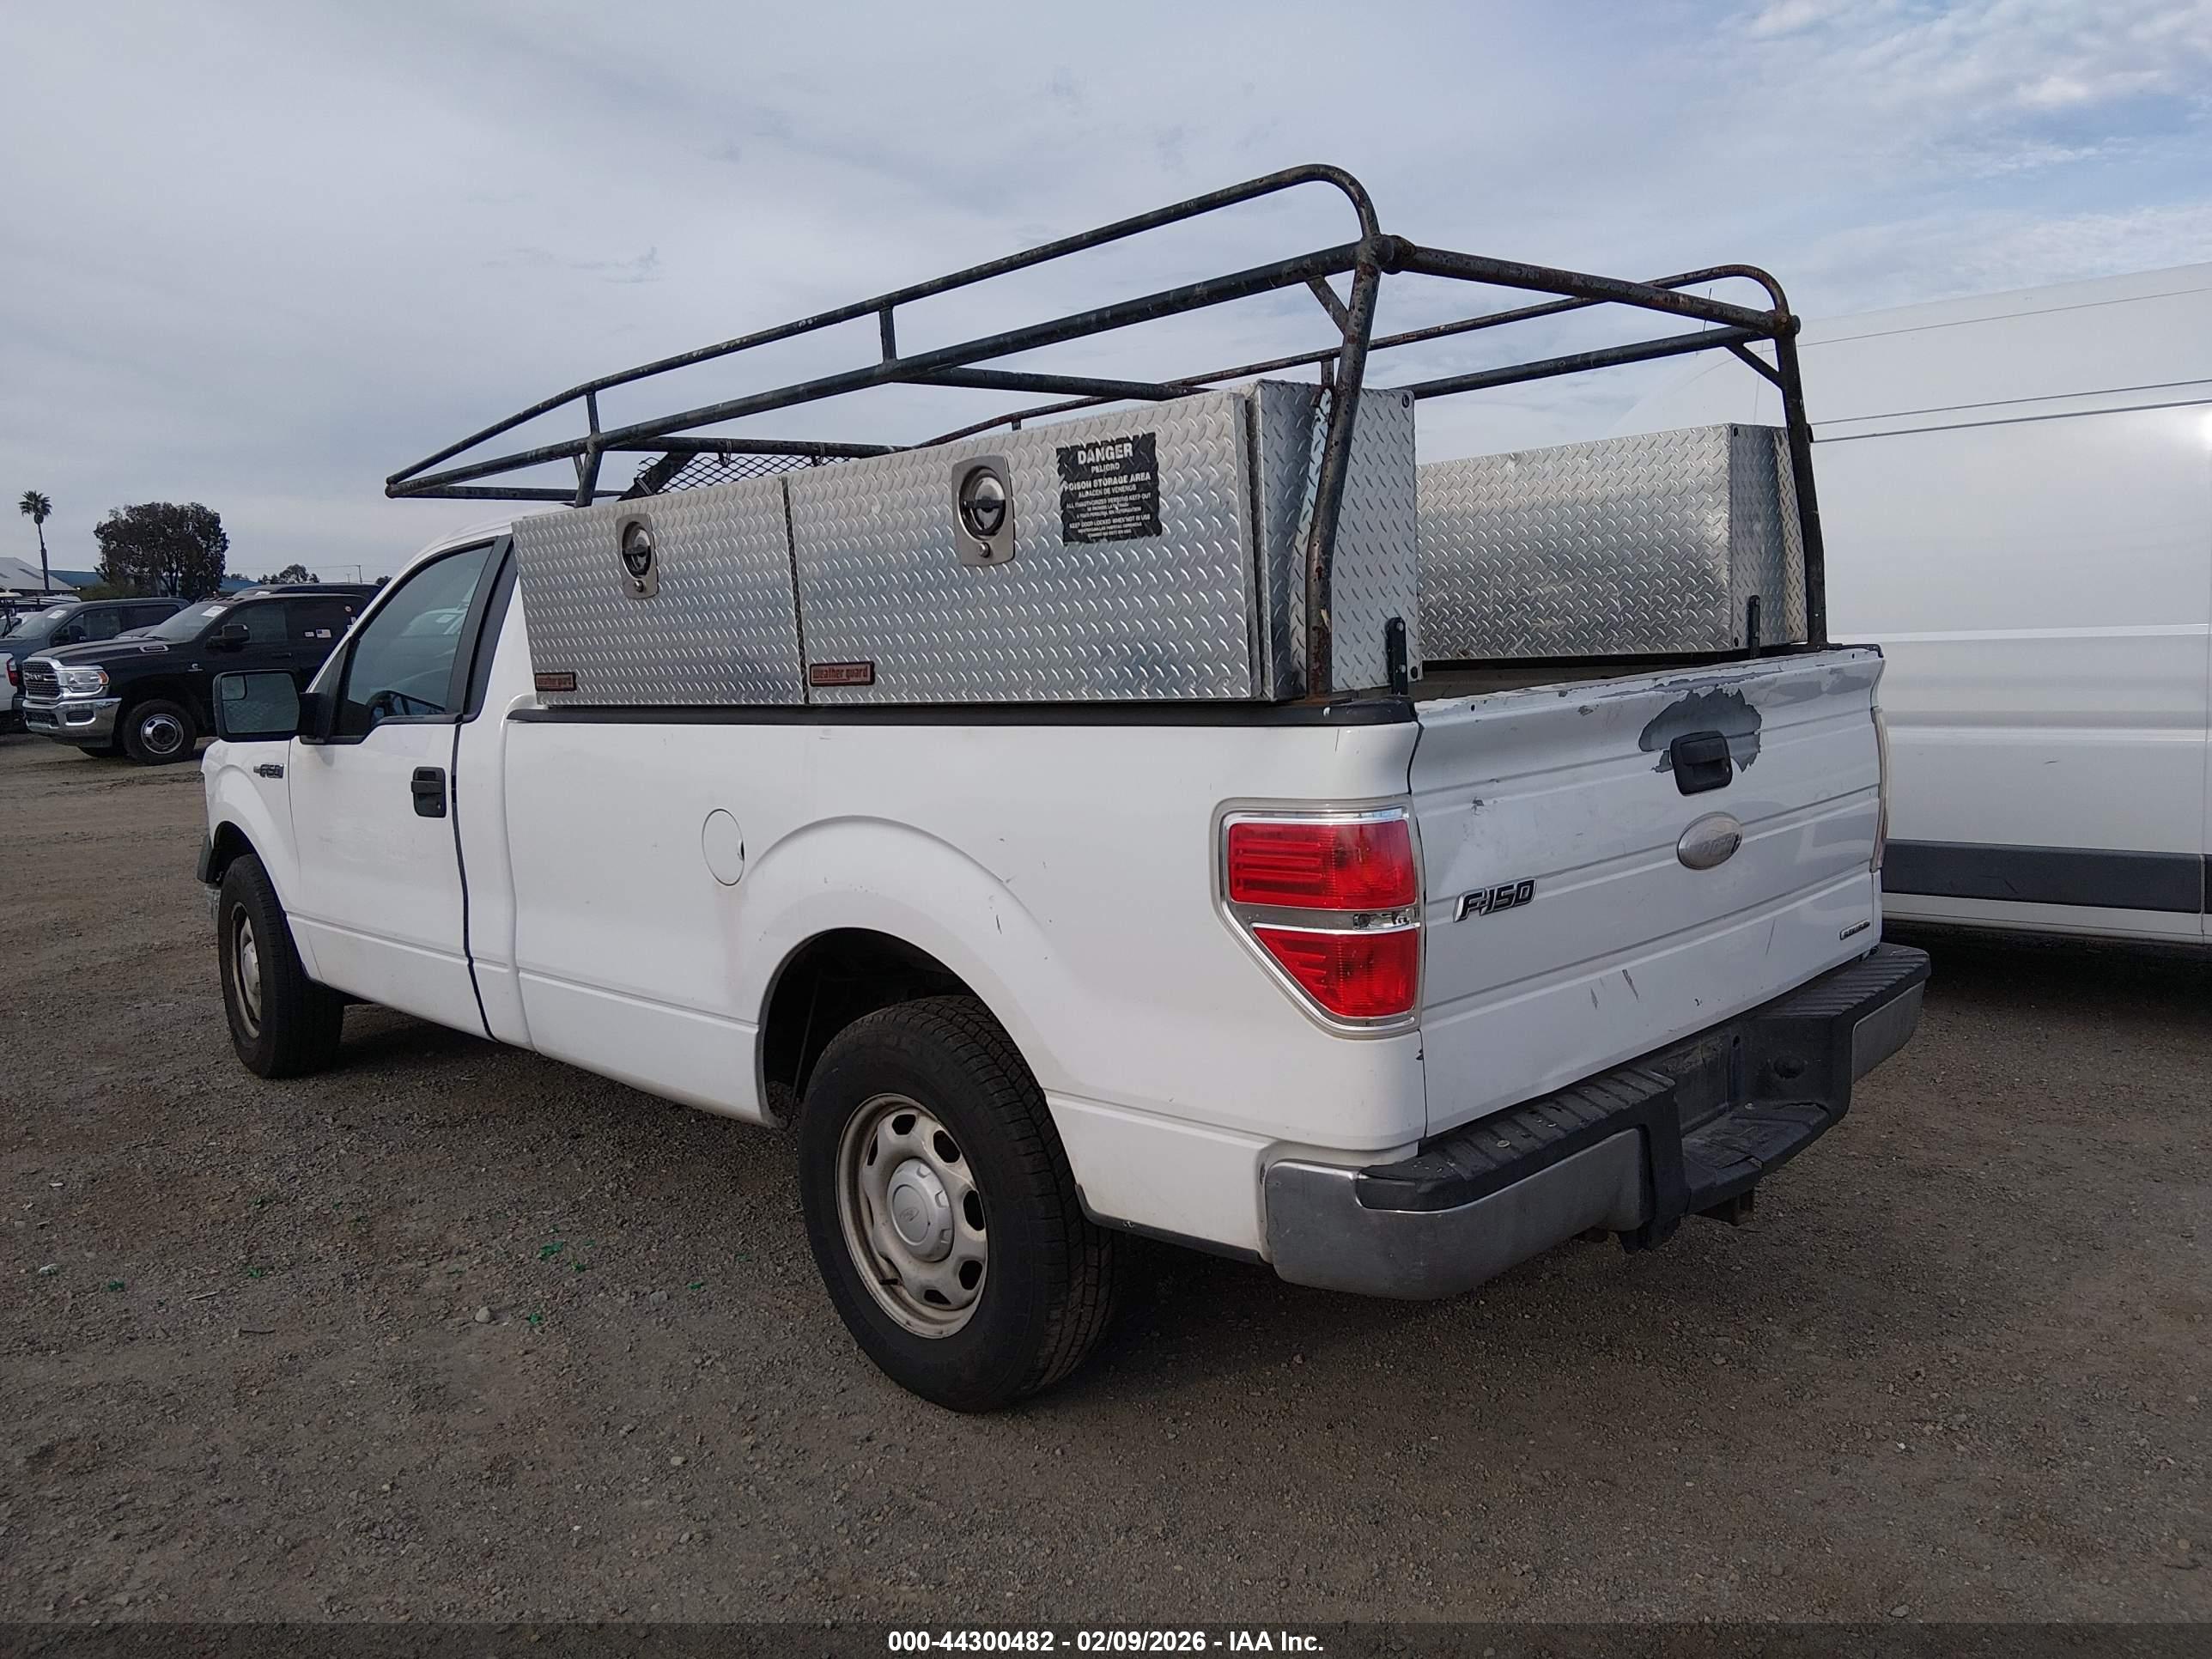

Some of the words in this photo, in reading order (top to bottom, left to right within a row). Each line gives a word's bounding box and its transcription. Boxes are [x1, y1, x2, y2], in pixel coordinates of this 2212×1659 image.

[1078, 443, 1133, 465] DANGER
[1093, 474, 1129, 488] STORAGE
[1130, 471, 1152, 483] AREA
[1453, 878, 1536, 923] F-150
